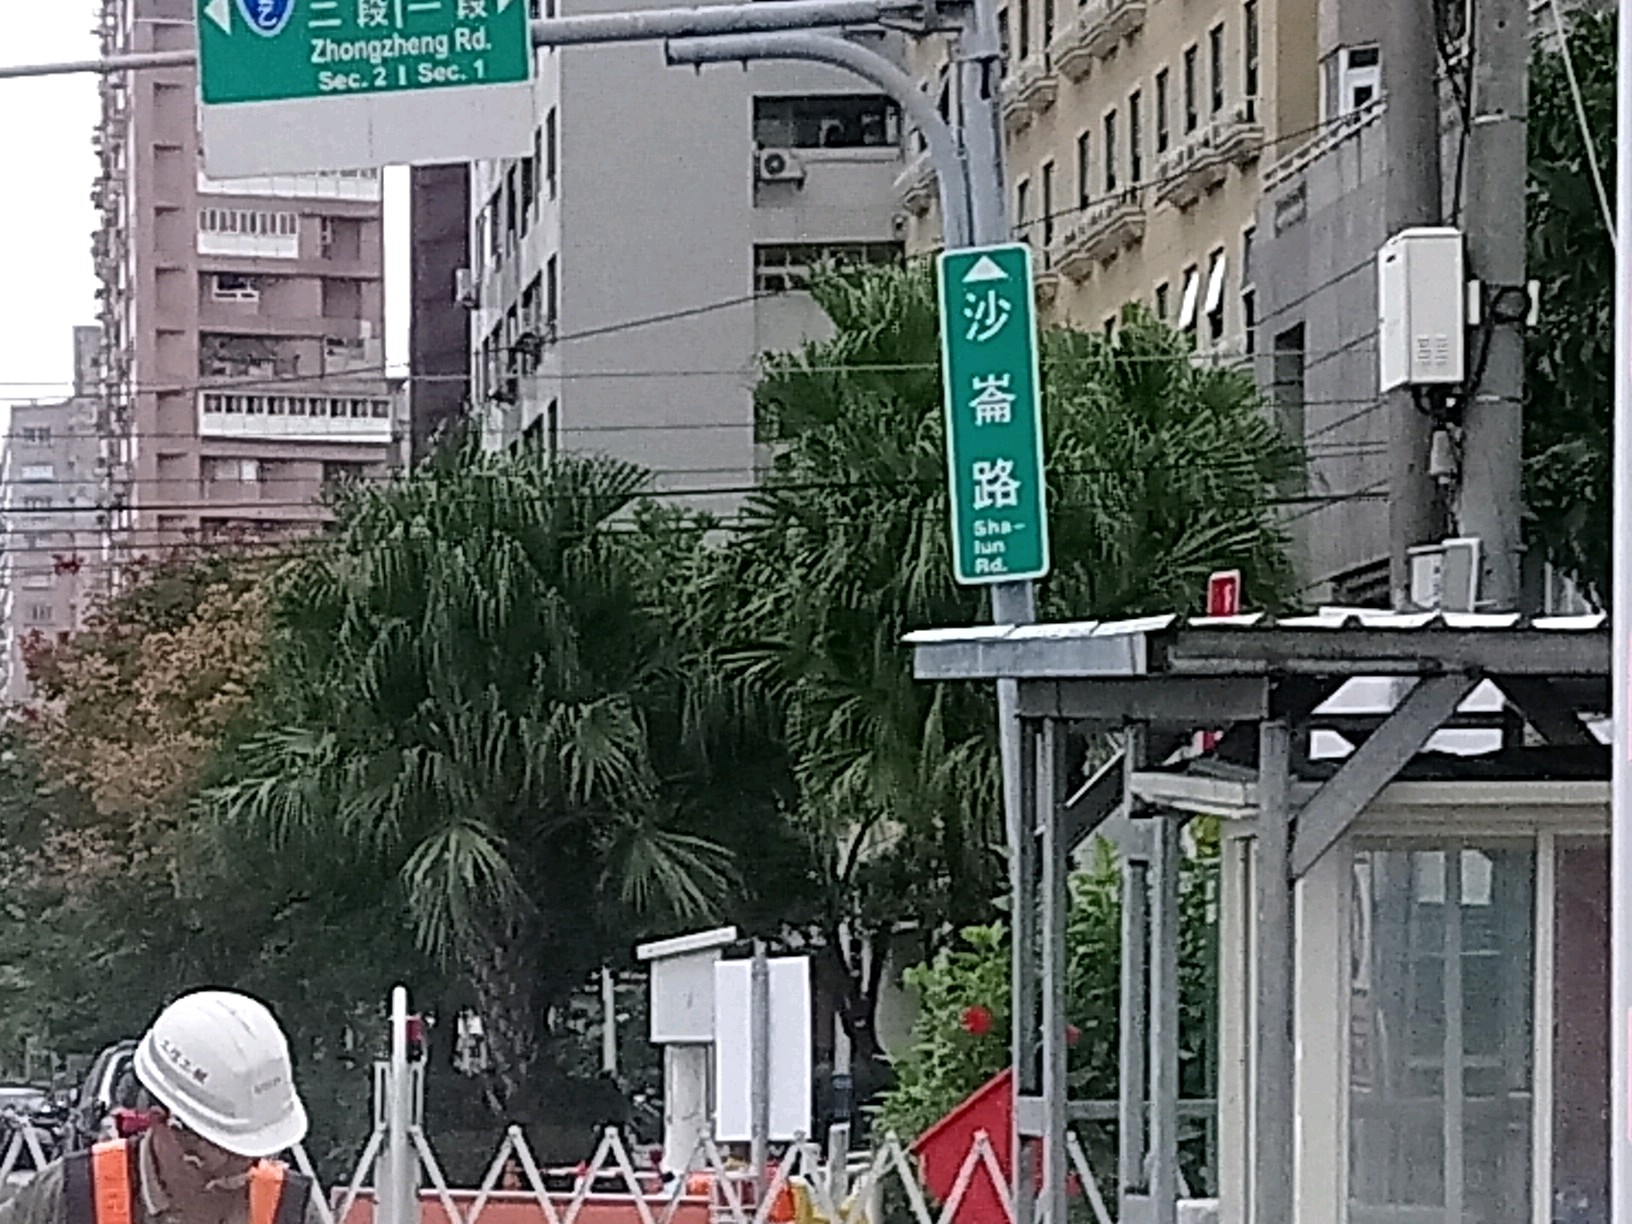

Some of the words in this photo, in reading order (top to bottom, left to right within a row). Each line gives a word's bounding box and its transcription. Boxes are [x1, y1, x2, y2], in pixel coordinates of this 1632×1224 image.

[311, 33, 448, 64] Zhongzheng
[454, 26, 492, 51] Rd.
[318, 70, 368, 91] Sec.
[373, 67, 387, 87] 2
[418, 62, 467, 83] Sec.
[473, 59, 485, 79] 1
[962, 289, 1022, 510] 沙崙路
[973, 519, 1026, 536] Sha-
[974, 541, 1006, 556] lun
[974, 558, 1008, 575] Rd.
